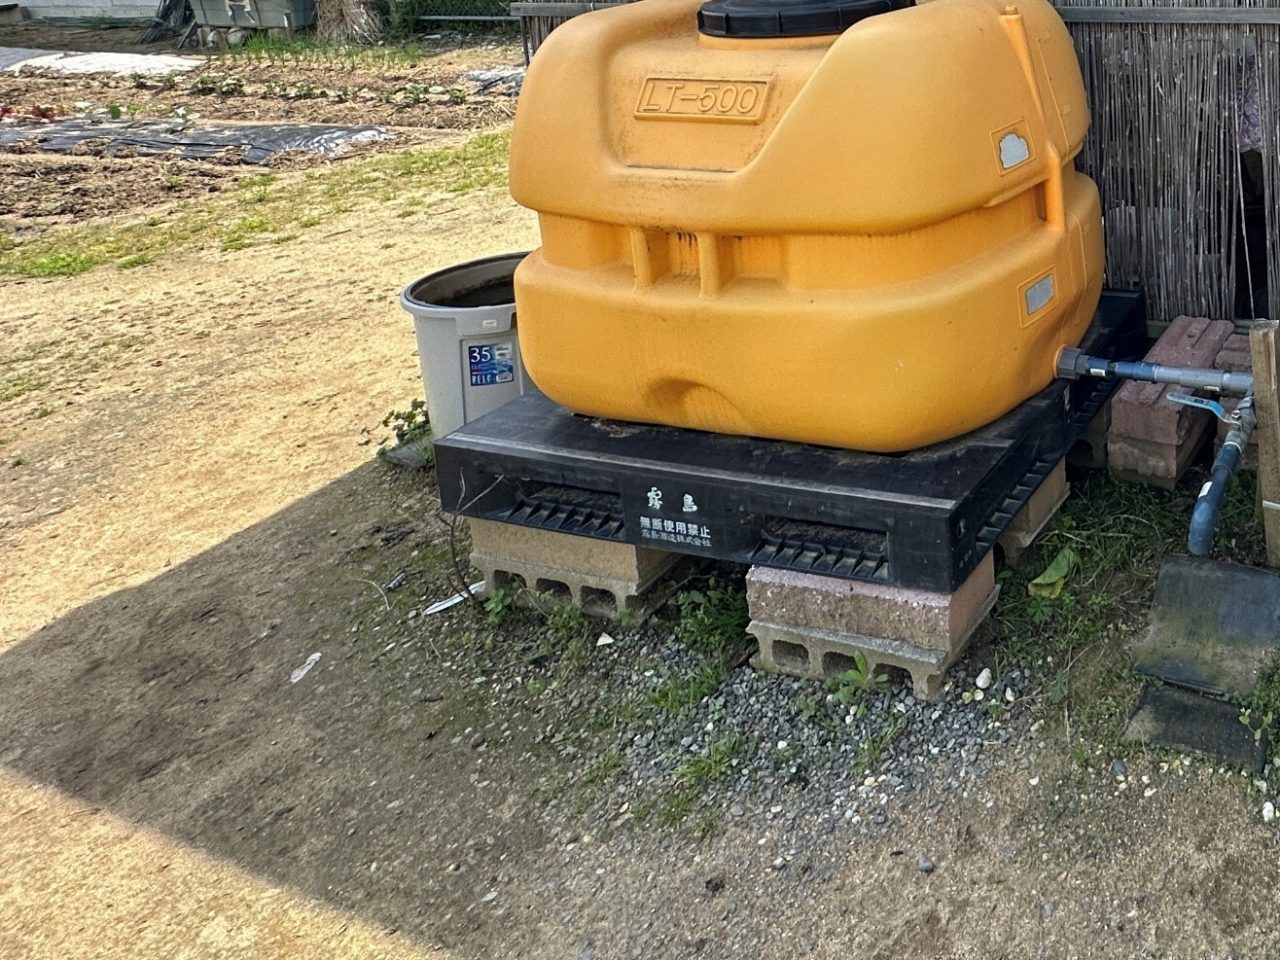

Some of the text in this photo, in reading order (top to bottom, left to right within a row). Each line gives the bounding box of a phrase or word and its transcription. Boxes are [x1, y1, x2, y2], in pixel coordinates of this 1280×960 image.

[642, 83, 758, 113] LT-500
[470, 347, 491, 362] 35
[640, 516, 711, 538] 無断使用禁止
